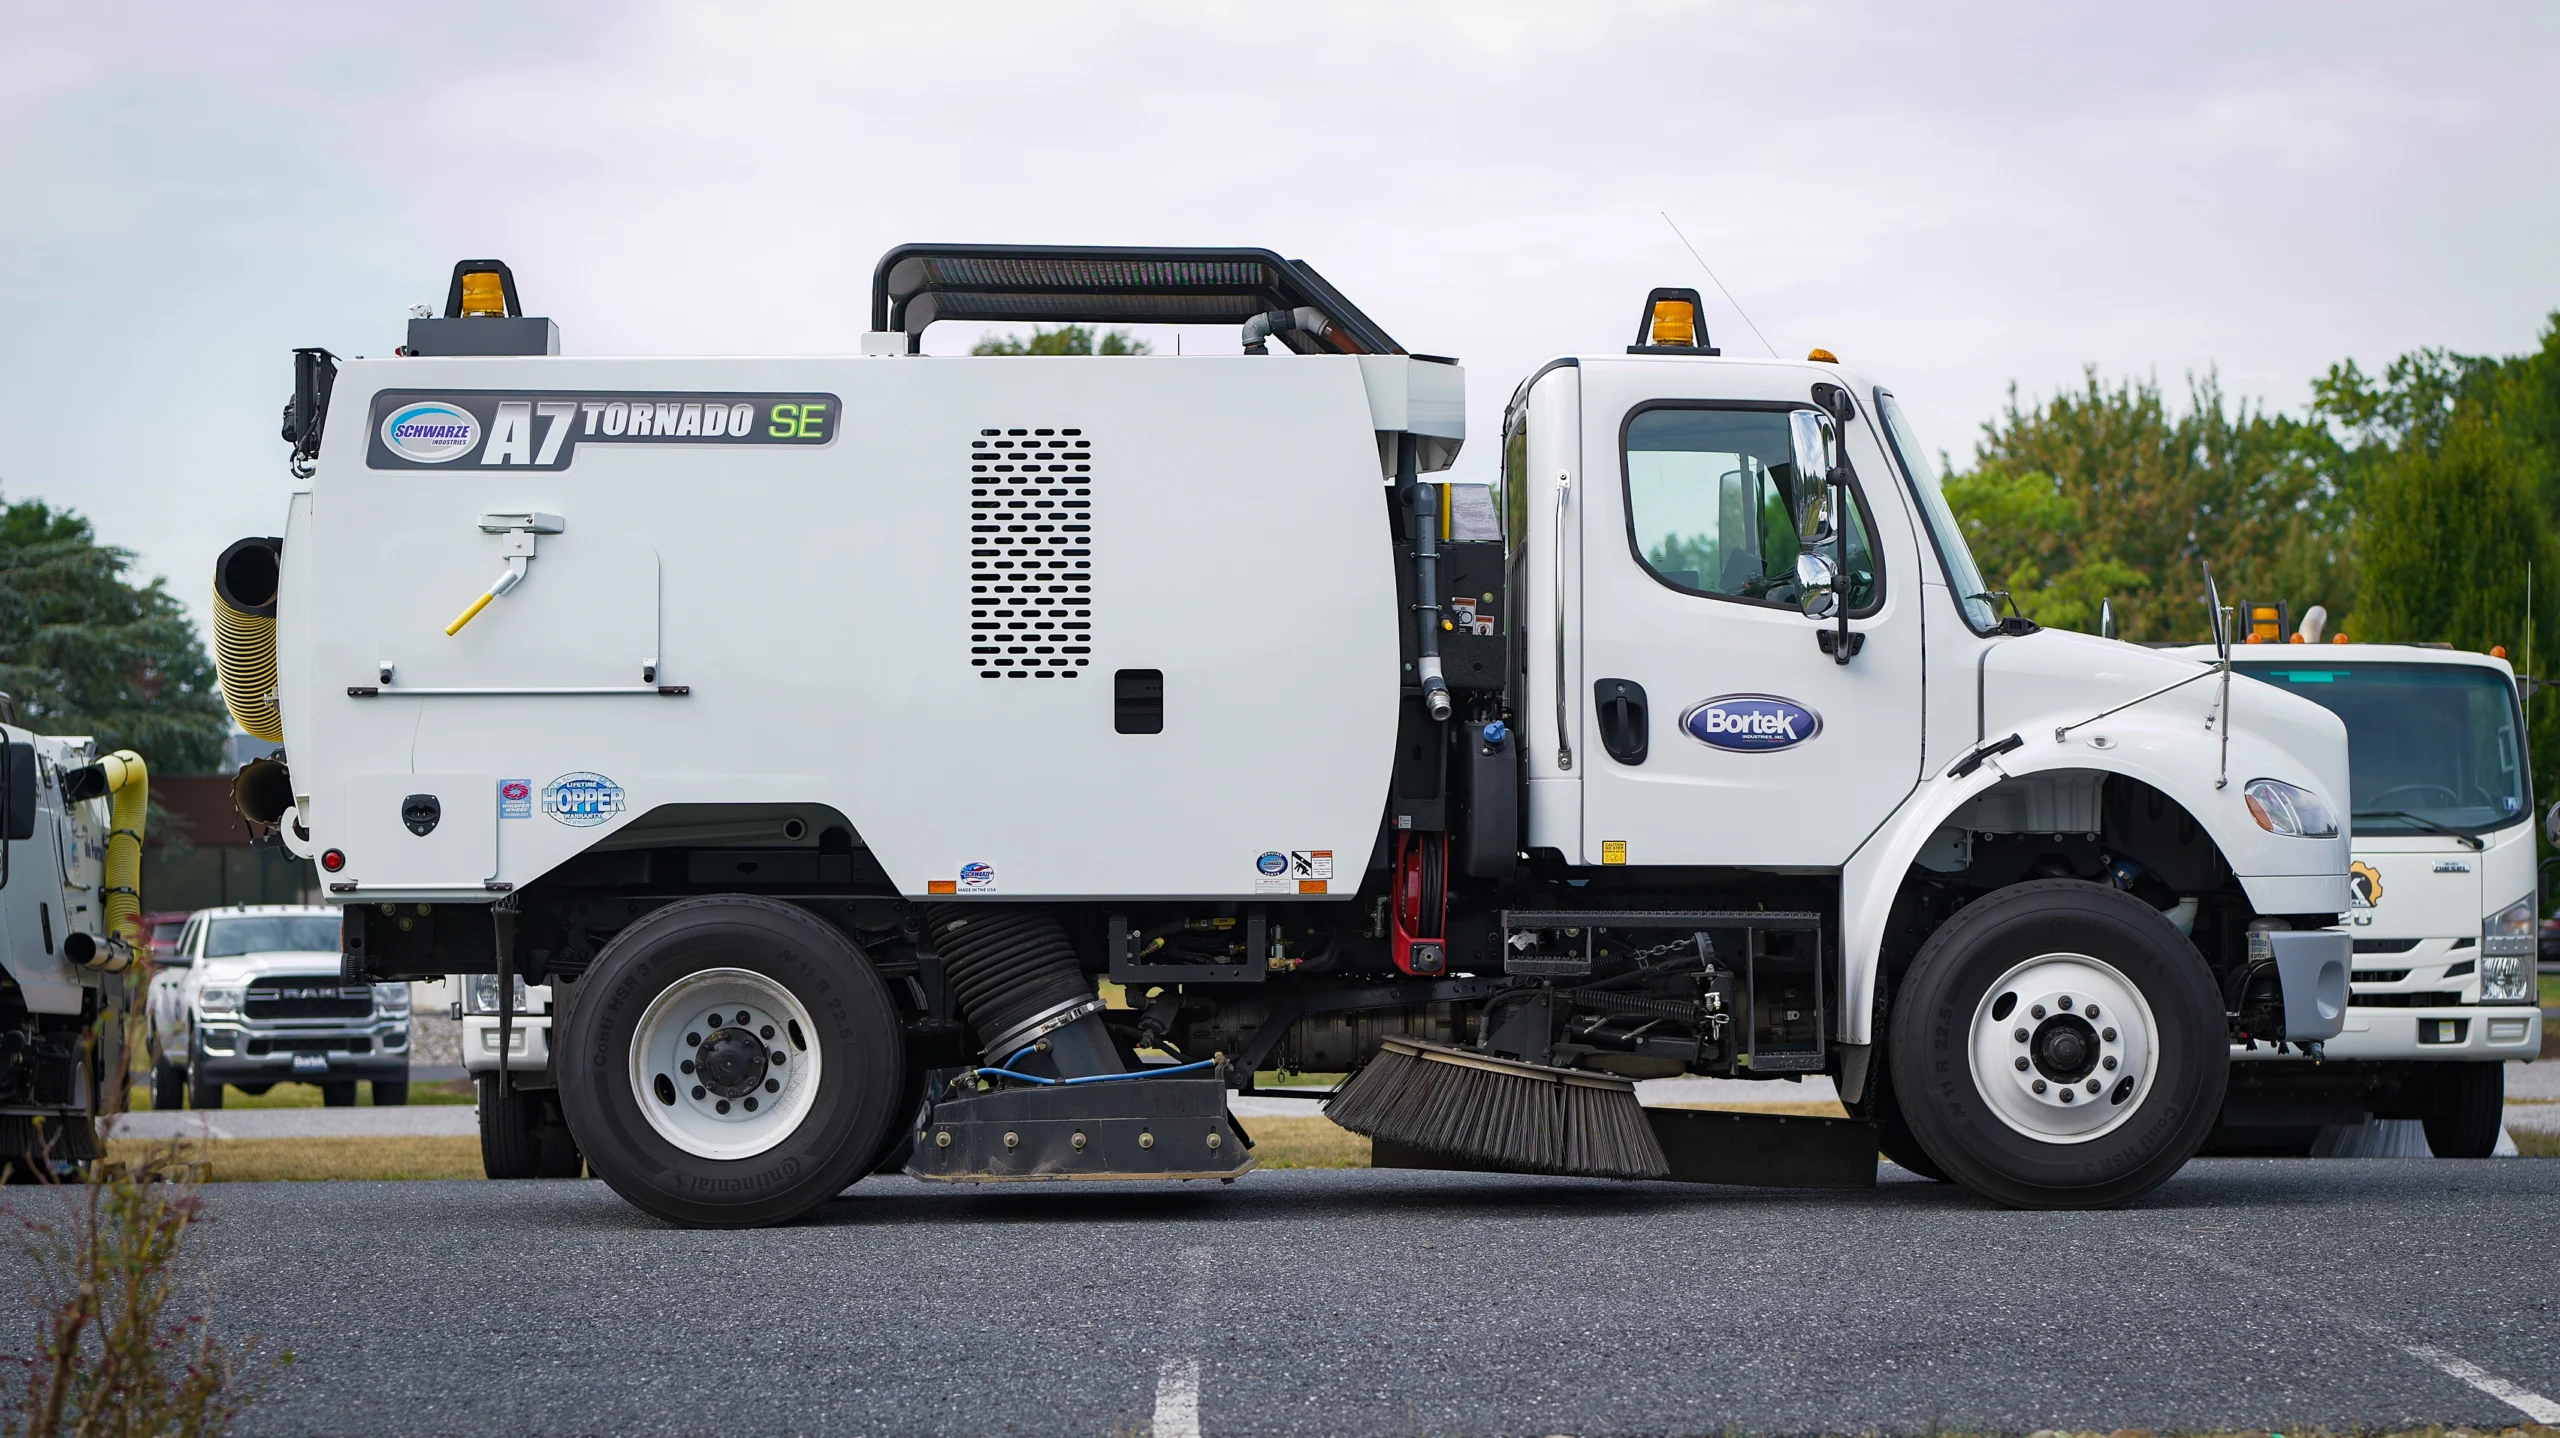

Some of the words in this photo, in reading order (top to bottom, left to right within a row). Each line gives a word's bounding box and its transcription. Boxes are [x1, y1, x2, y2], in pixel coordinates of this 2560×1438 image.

[395, 425, 470, 438] SCHWARZE
[481, 401, 577, 464] A7
[582, 403, 755, 437] TORNADO
[769, 404, 826, 437] SE
[1706, 709, 1797, 739] Bortek
[541, 787, 626, 813] HOPPER
[283, 988, 337, 999] RAM
[593, 1016, 615, 1067] Conti
[607, 974, 640, 1013] HSR
[689, 1156, 802, 1193] Continental
